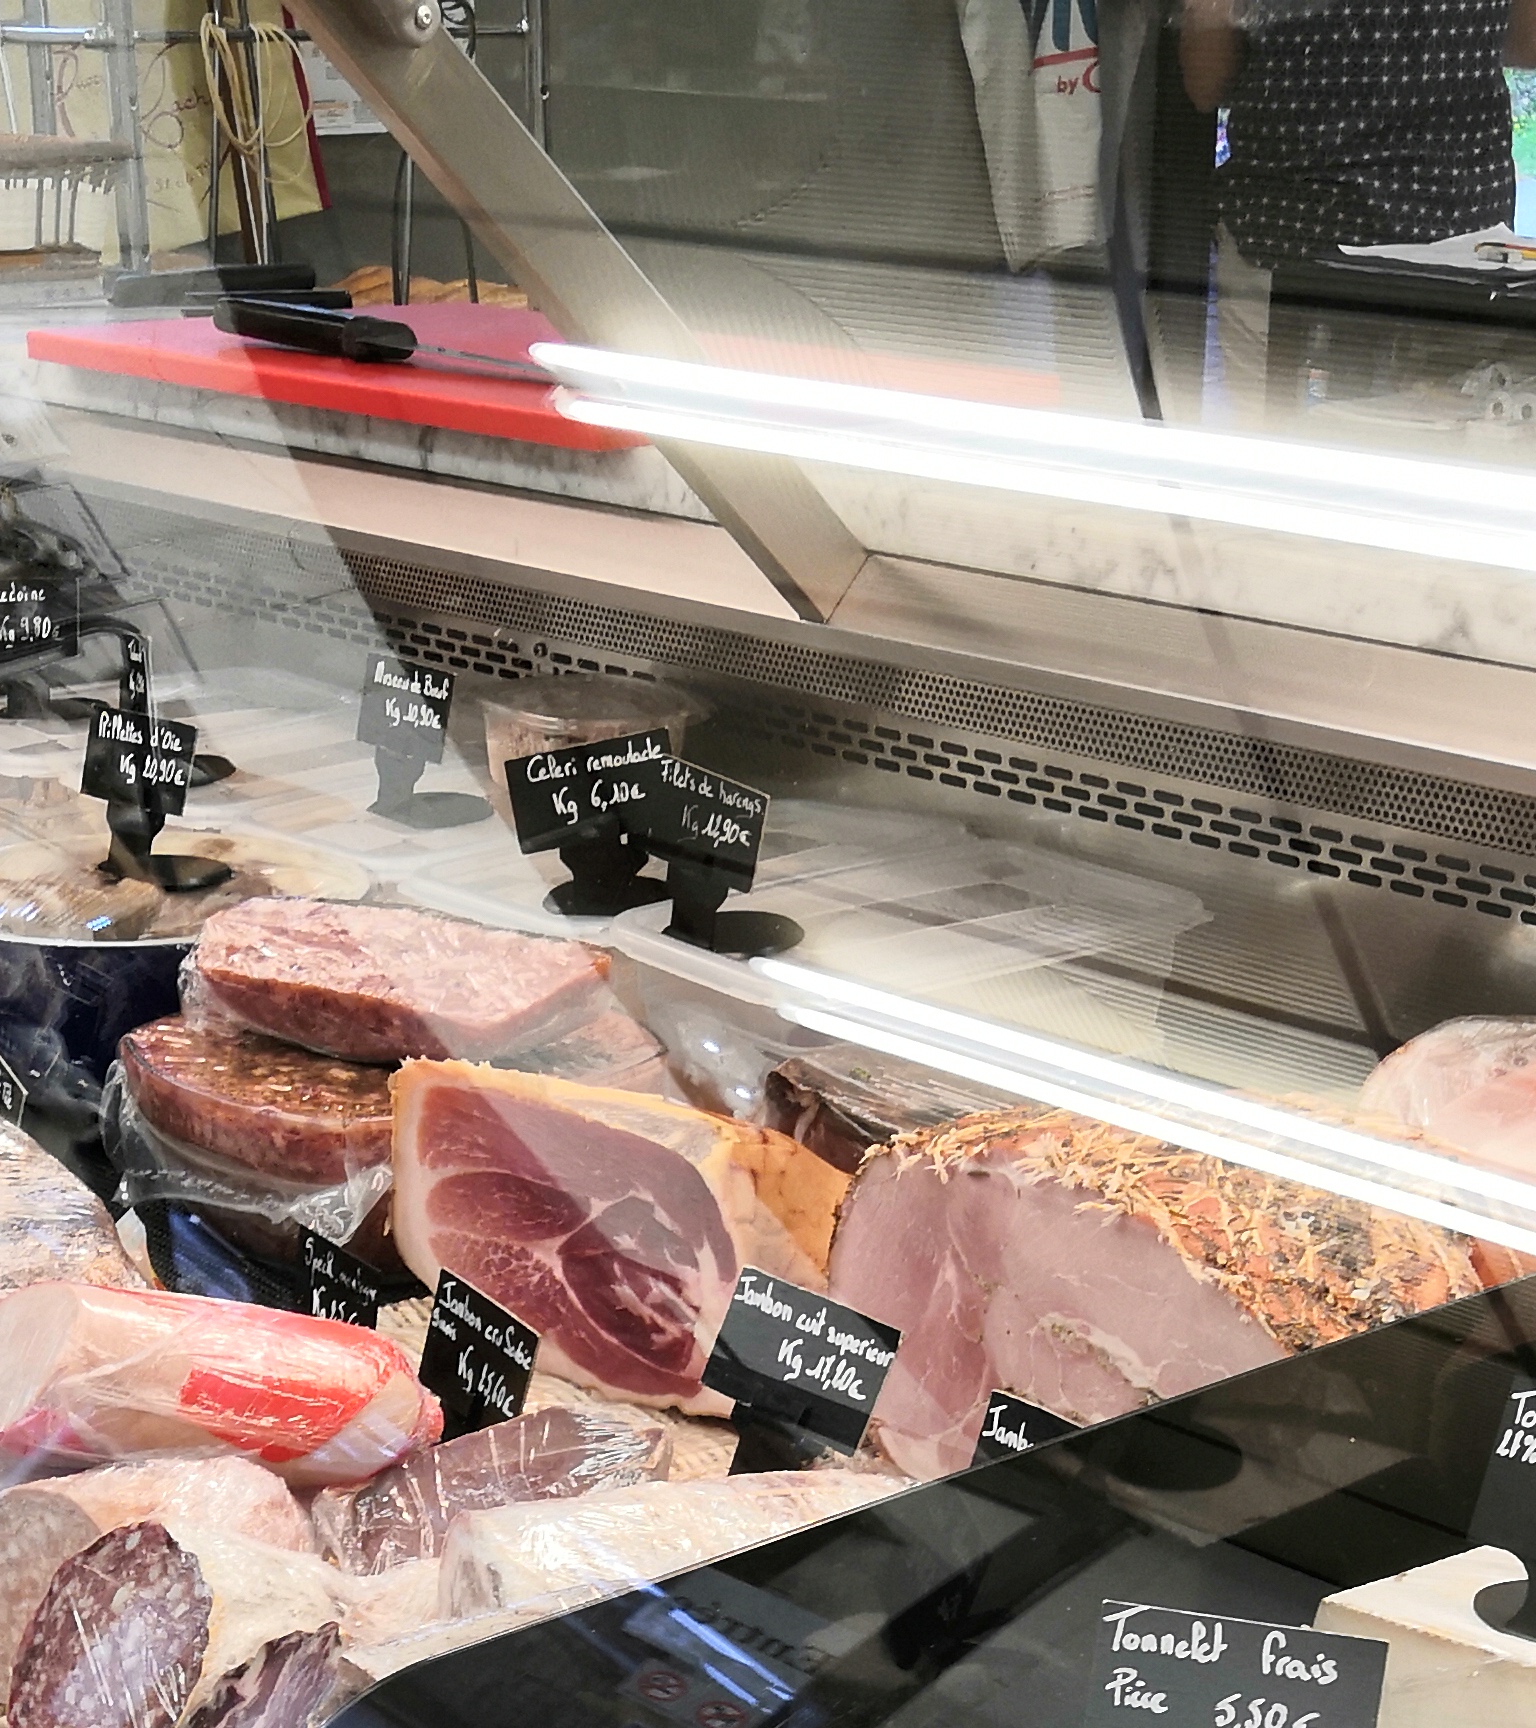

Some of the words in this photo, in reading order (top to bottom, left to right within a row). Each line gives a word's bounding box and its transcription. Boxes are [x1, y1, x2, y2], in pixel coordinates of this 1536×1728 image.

[384, 696, 401, 728] Kg
[120, 753, 136, 785] Kg
[697, 773, 715, 800] de
[551, 787, 578, 826] Kg
[589, 780, 647, 814] 6,10€
[680, 803, 700, 843] Kg
[733, 1275, 794, 1323] Jambon
[457, 1344, 475, 1395] Kg
[777, 1338, 804, 1382] Kg
[981, 1404, 1035, 1452] Jamb
[1102, 1604, 1228, 1664] Tonnelet
